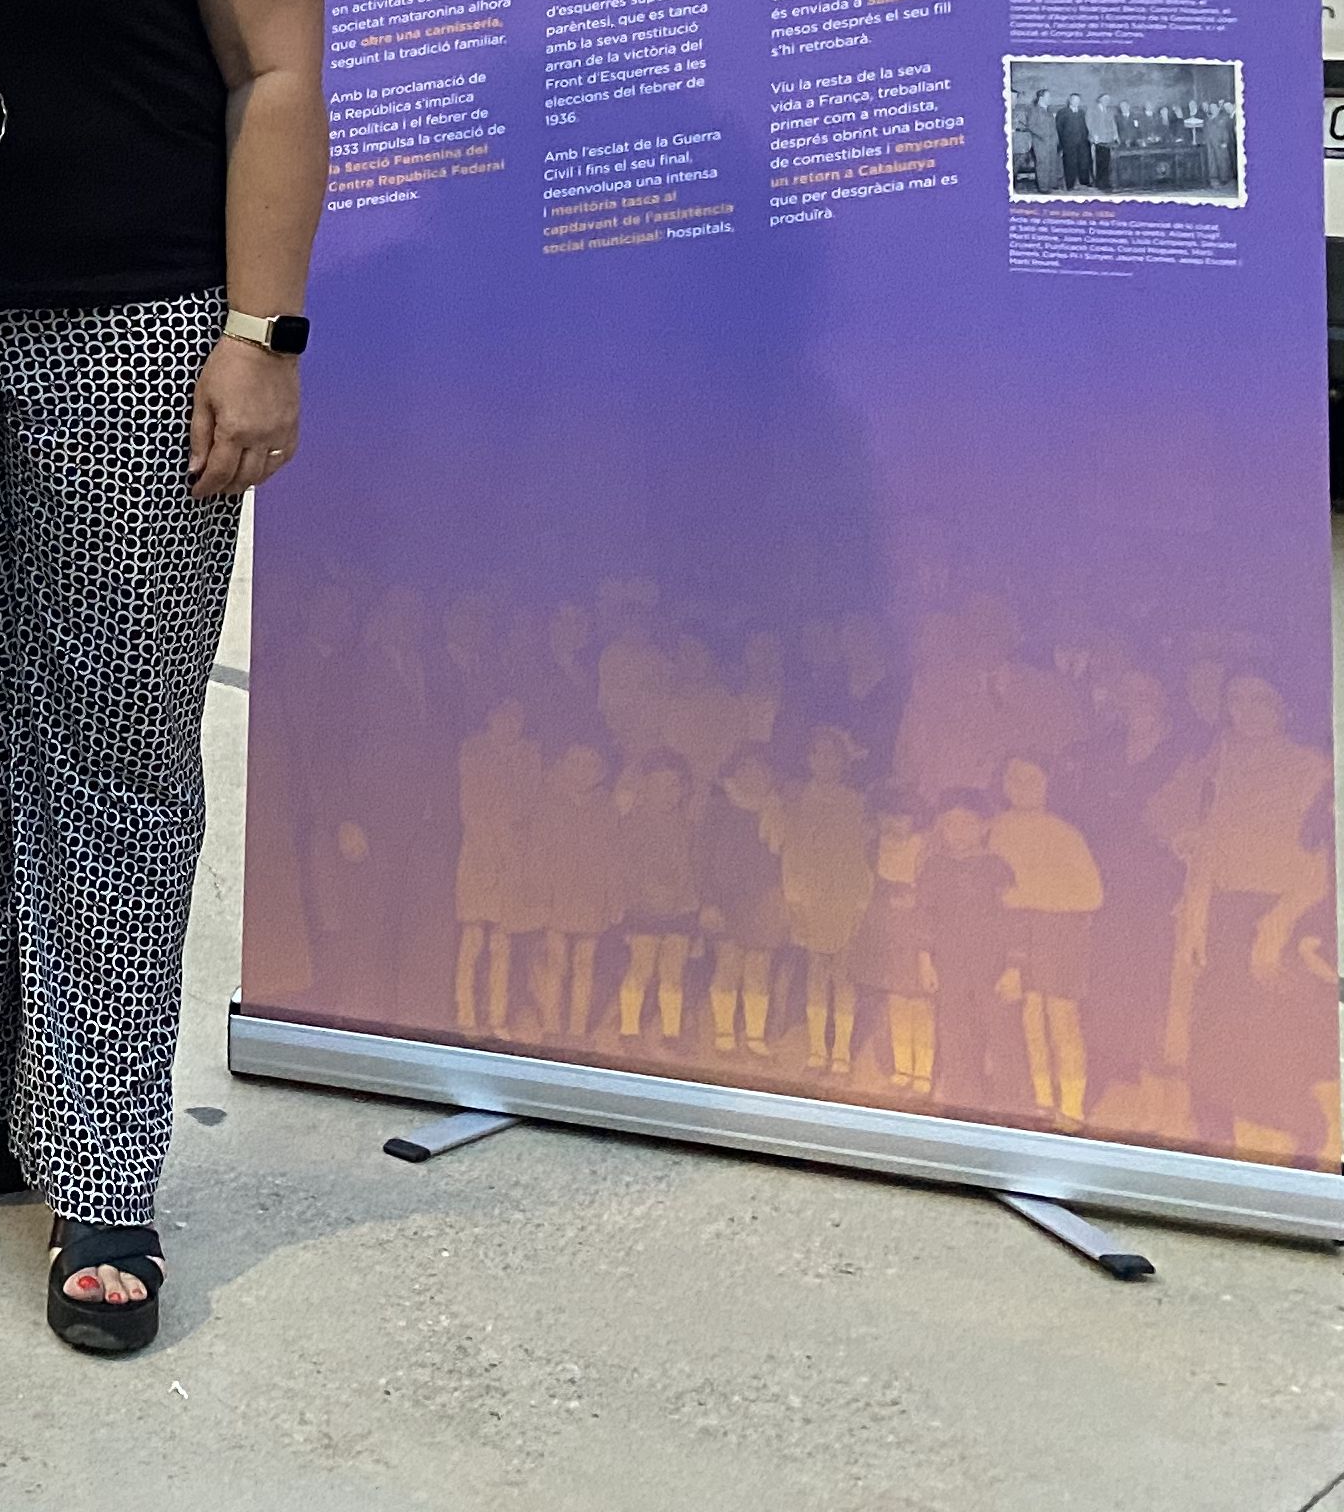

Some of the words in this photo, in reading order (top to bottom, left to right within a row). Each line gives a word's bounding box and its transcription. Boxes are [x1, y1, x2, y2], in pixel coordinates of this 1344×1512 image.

[332, 16, 384, 33] societat
[388, 5, 464, 24] mataronina
[468, 0, 510, 12] alhora
[771, 23, 817, 38] mesos
[822, 13, 880, 30] després
[885, 9, 898, 21] el
[903, 7, 928, 18] seu
[934, 1, 950, 14] fill
[330, 90, 362, 104] Amb
[366, 88, 377, 98] la
[381, 74, 464, 97] proclamació
[468, 72, 485, 83] de
[545, 75, 582, 89] Front
[587, 64, 669, 83] d'Esquerres
[673, 62, 681, 71] a
[686, 59, 706, 69] les
[770, 117, 819, 133] primer
[823, 112, 855, 124] com
[860, 110, 868, 119] a
[873, 101, 937, 116] modista,
[770, 133, 827, 149] després
[833, 126, 877, 141] obrint
[882, 124, 909, 135] una
[914, 116, 963, 130] botiga
[543, 180, 631, 199] desenvolupa
[636, 176, 661, 187] una
[666, 169, 717, 183] intensa
